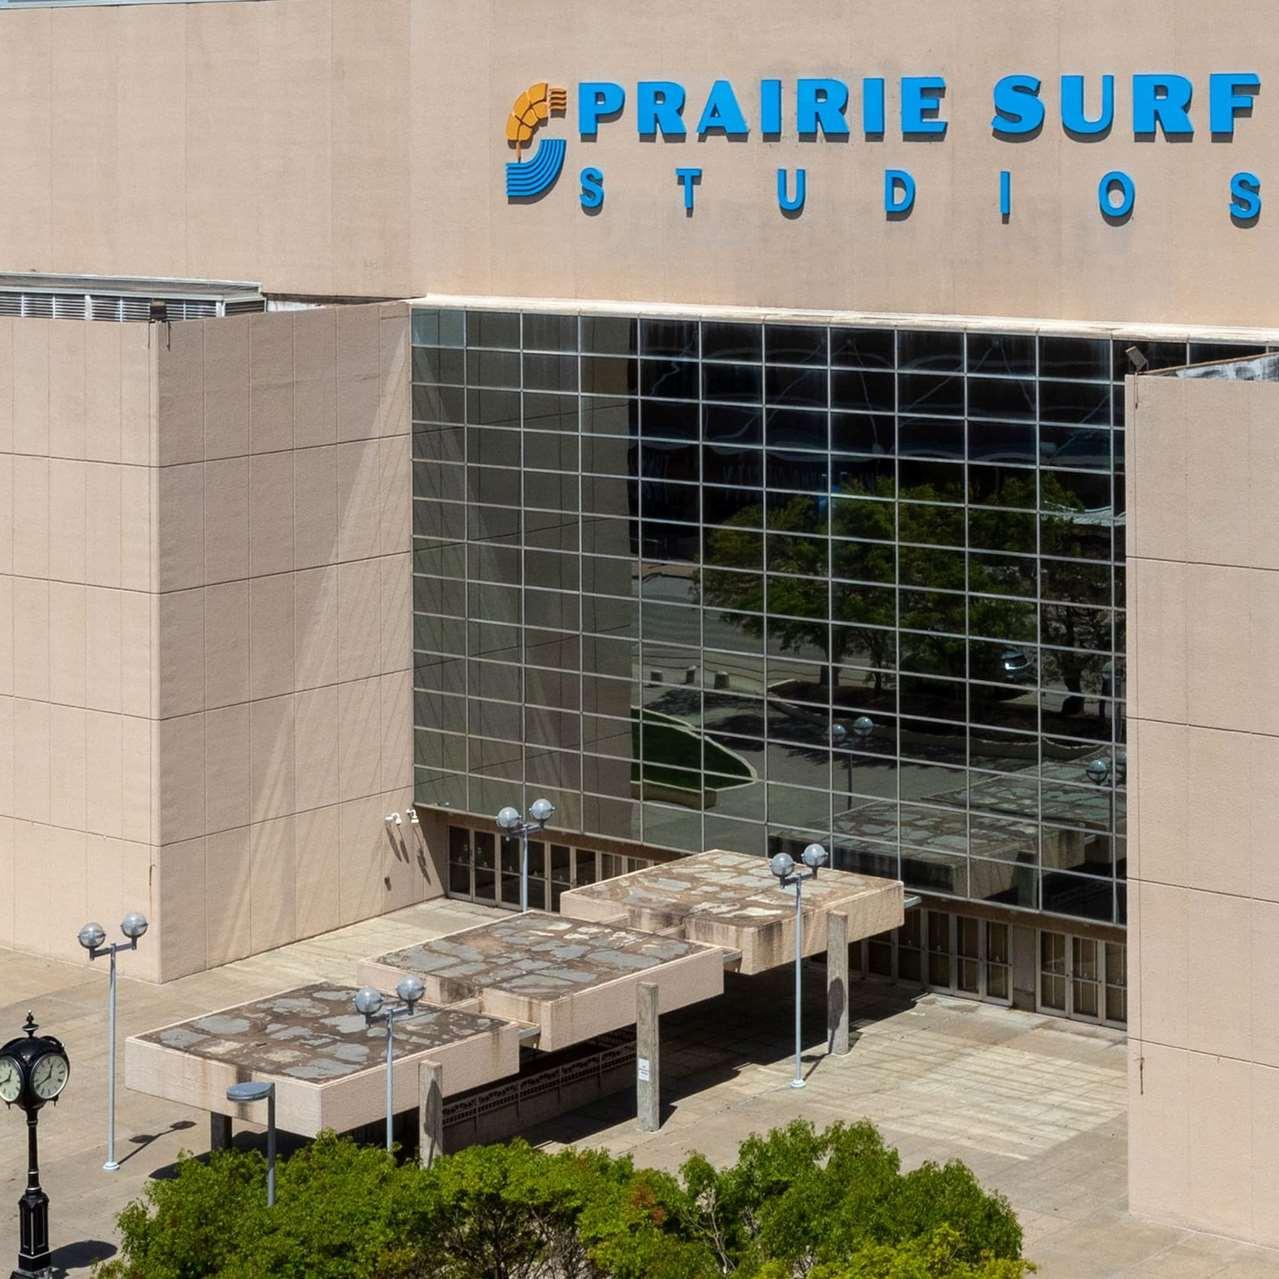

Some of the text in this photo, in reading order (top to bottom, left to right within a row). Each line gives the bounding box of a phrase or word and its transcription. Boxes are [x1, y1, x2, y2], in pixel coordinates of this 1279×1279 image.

[578, 73, 1261, 138] PRAIRIE SURF
[579, 166, 1263, 223] STUDIOS
